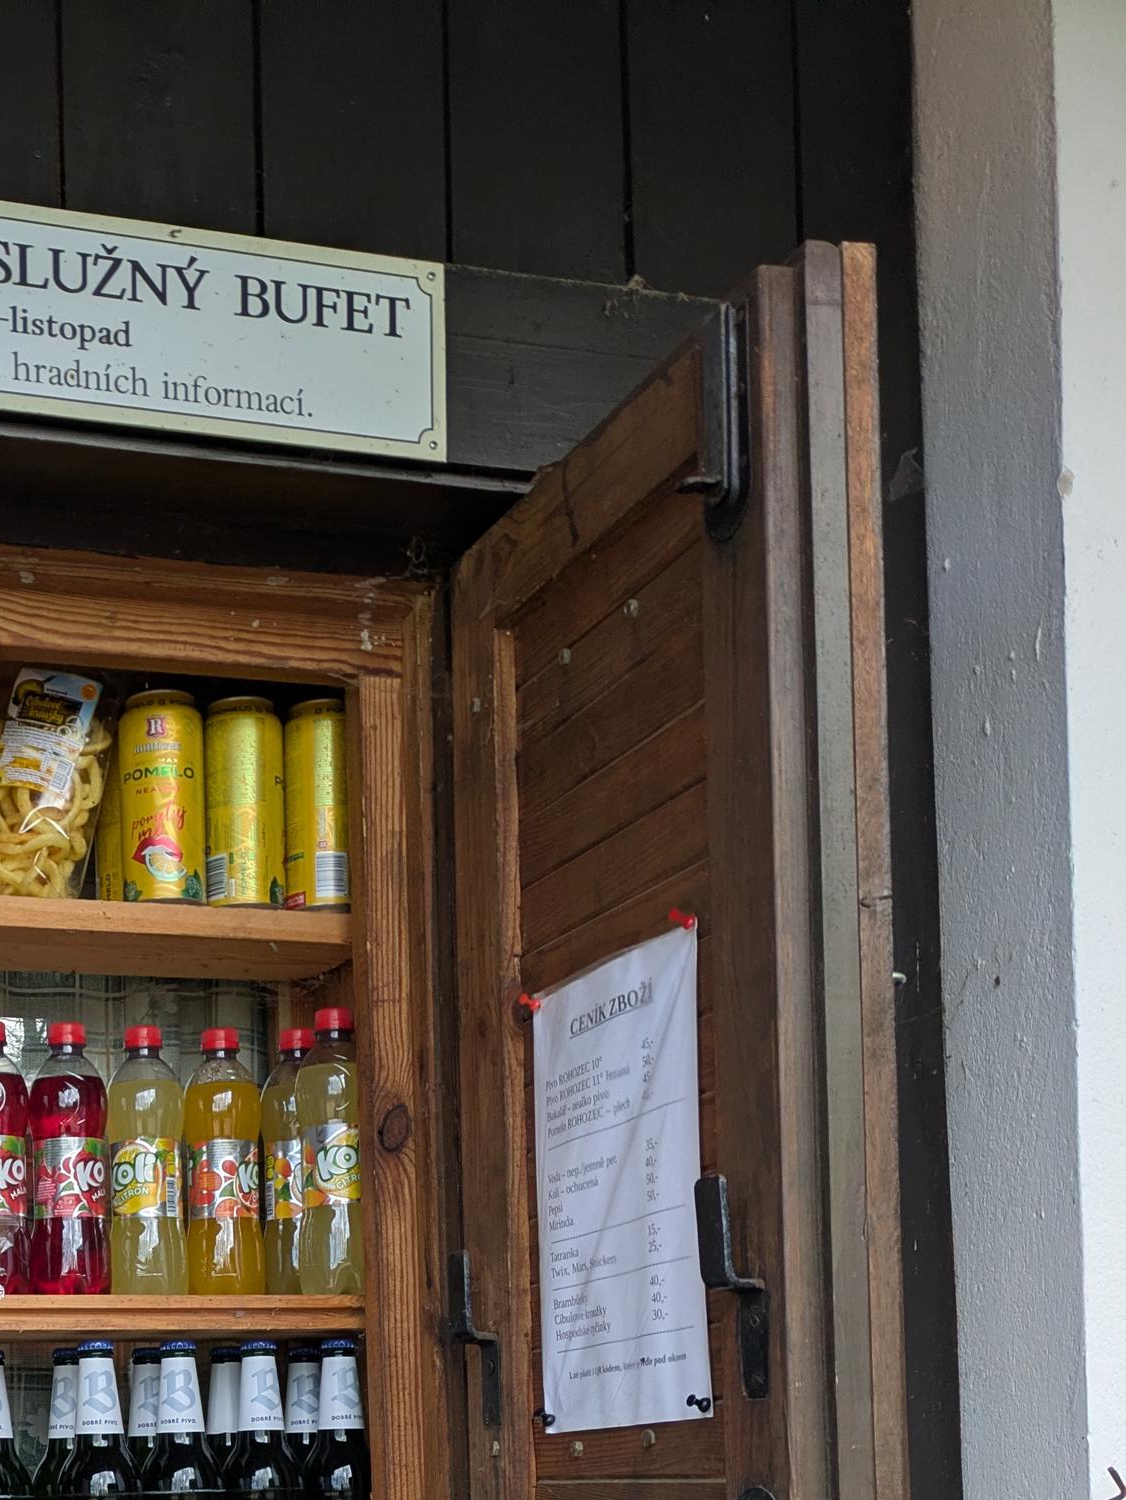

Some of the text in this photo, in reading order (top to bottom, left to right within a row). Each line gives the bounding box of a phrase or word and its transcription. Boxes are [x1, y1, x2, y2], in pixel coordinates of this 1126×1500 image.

[234, 274, 411, 339] BUFET
[13, 350, 150, 398] hradních
[161, 371, 314, 419] informací.
[123, 764, 195, 785] POMELO
[569, 977, 653, 1036] CENÍK ZBOŽÍ
